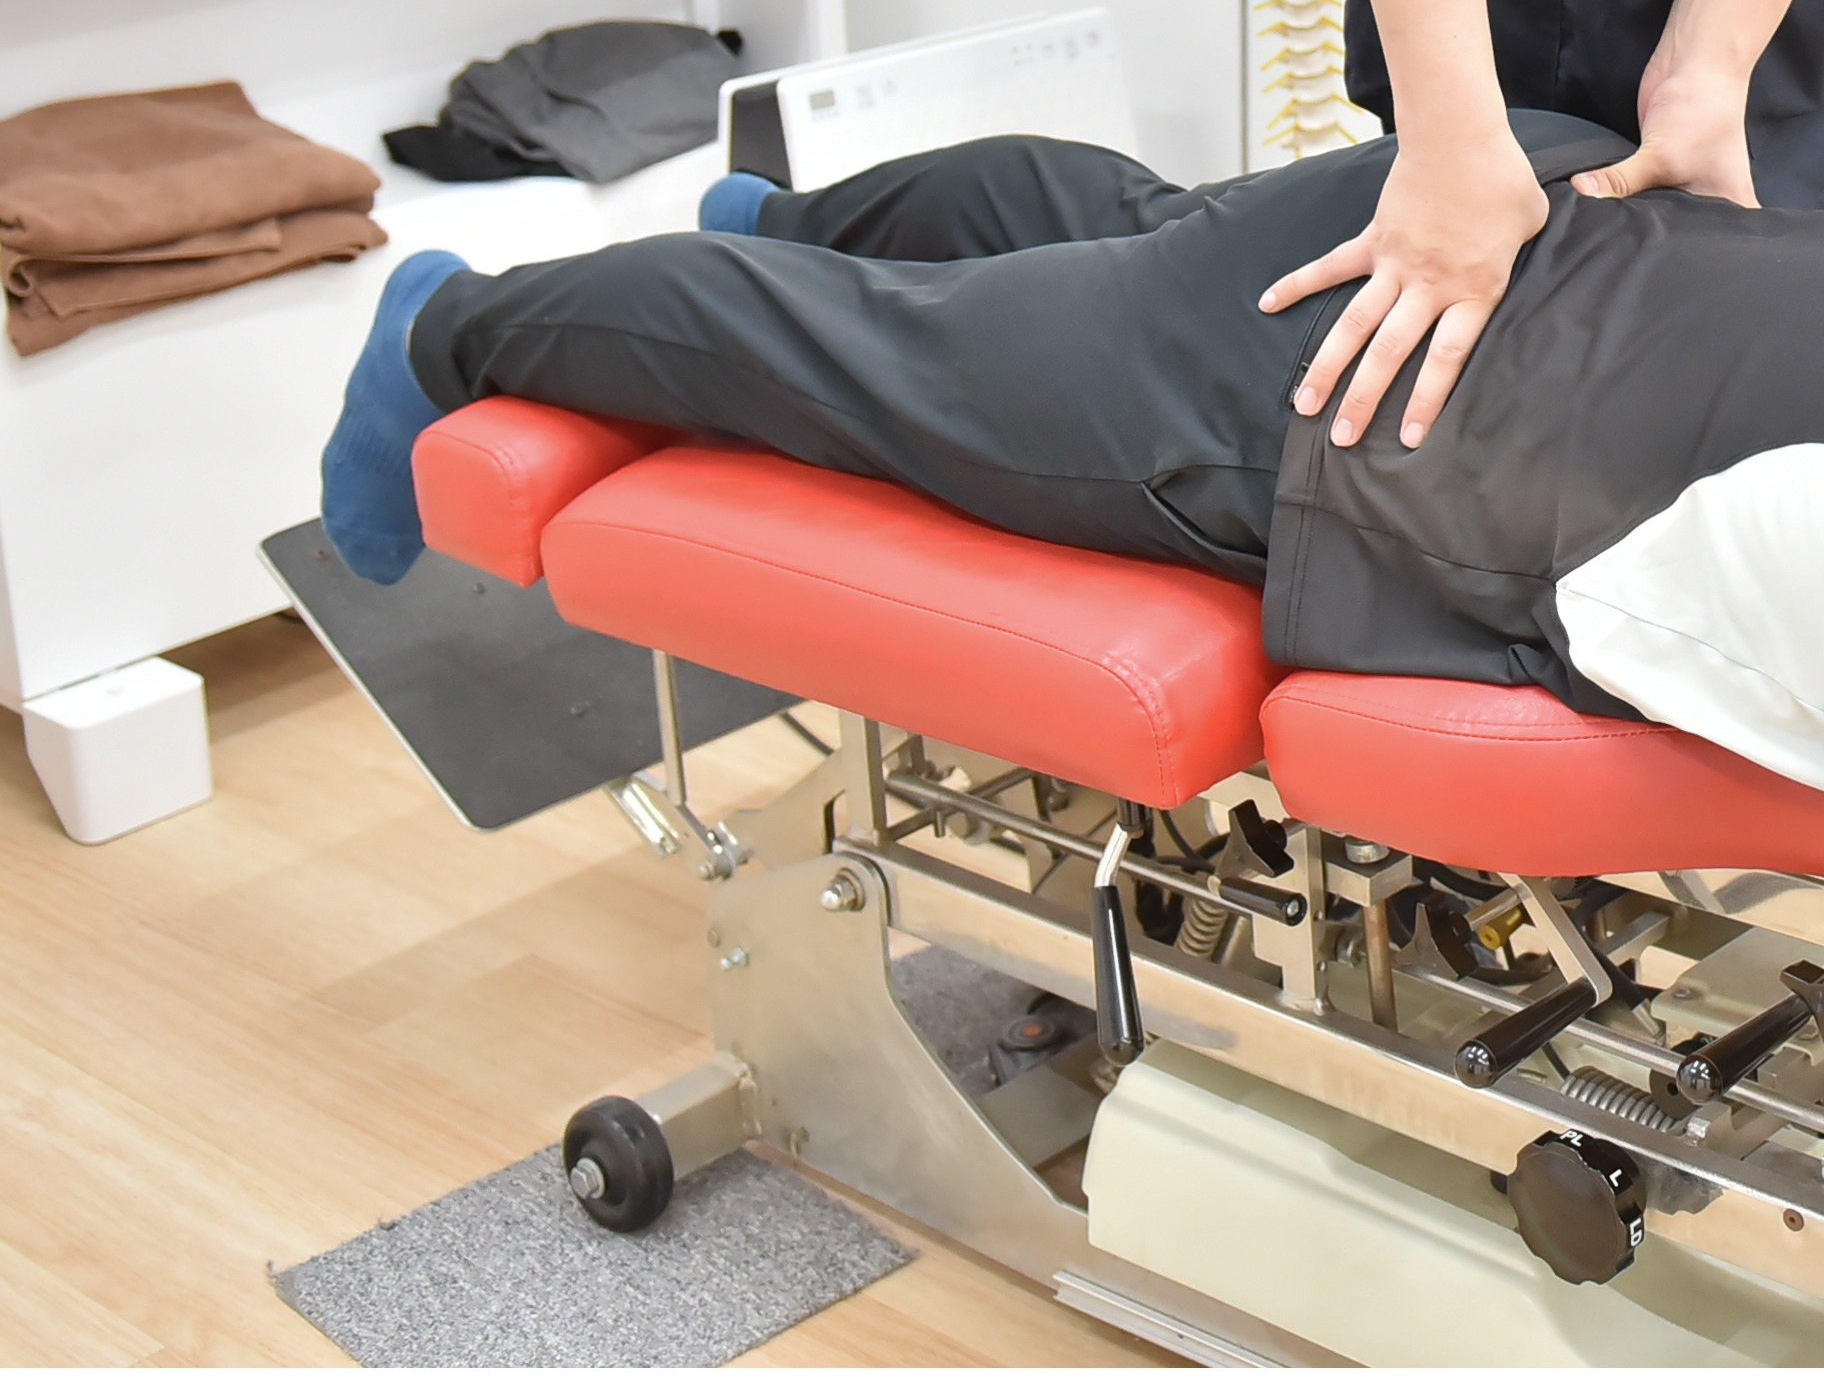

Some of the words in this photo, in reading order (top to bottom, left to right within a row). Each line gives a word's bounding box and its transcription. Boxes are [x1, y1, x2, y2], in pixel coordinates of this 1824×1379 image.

[1560, 1129, 1584, 1147] PL
[1609, 1168, 1622, 1188] L
[1629, 1217, 1643, 1248] LD
